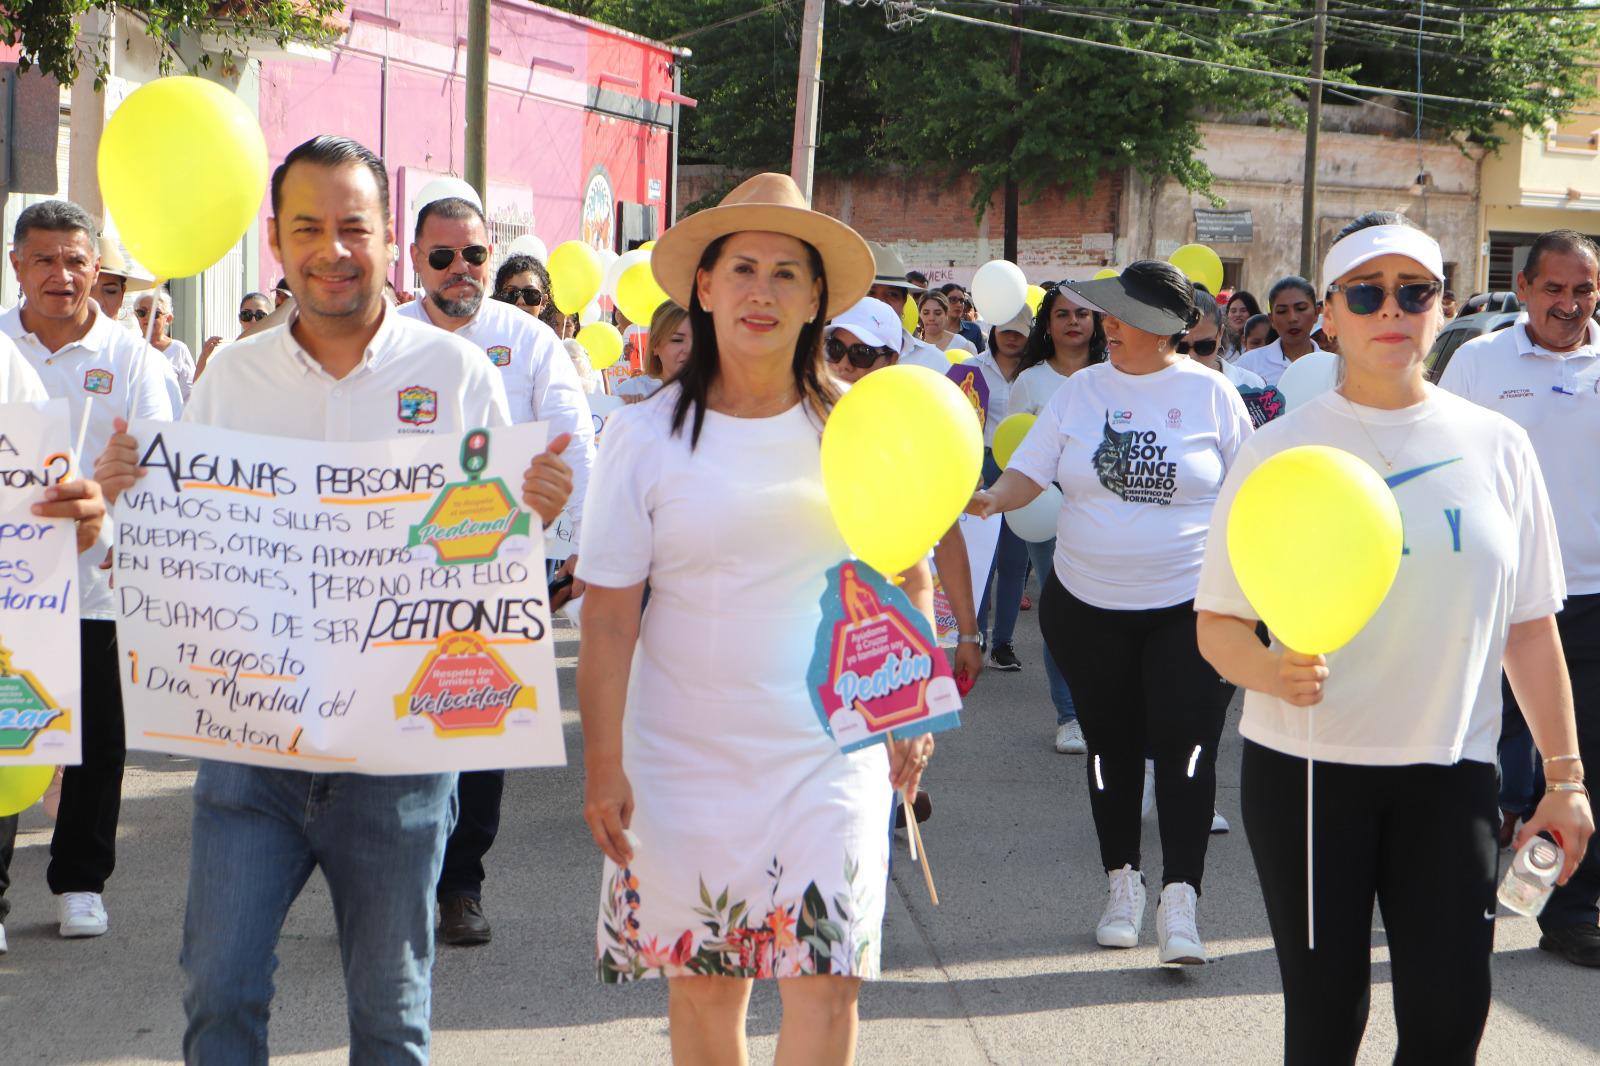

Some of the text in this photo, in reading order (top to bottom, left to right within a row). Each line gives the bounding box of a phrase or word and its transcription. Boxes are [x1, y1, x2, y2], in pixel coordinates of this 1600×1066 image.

[1128, 444, 1168, 460] SOY
[1134, 430, 1157, 444] YO
[139, 432, 445, 496] ALGUNAS PERSONAS
[1125, 460, 1177, 478] LINCE
[123, 491, 395, 533] VAMOS EN SILLAS DE
[418, 505, 521, 544] Peatonal
[227, 533, 303, 564] OTRAS
[312, 543, 412, 567] APOYADAS
[117, 551, 528, 609] EN BASTONES, PERO NO POR ELLO
[119, 585, 545, 653] DEJAMOS DE SER PEATONES
[177, 643, 305, 681] 17 agosto
[318, 689, 356, 718] del
[408, 682, 522, 716] Velocidad
